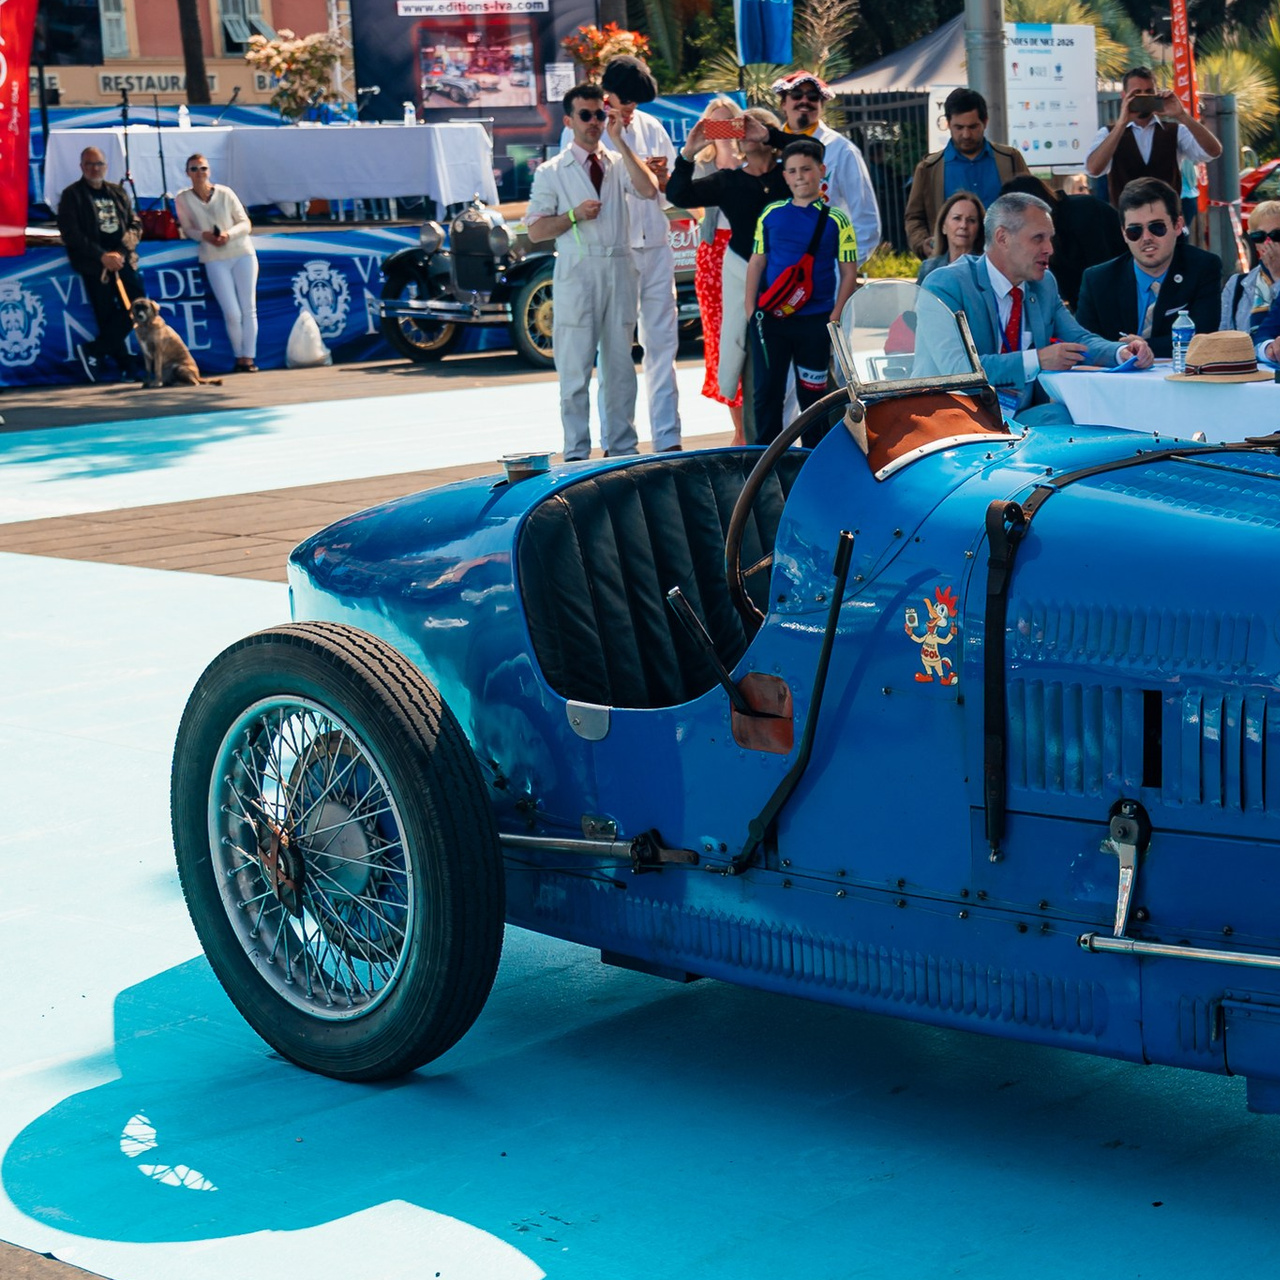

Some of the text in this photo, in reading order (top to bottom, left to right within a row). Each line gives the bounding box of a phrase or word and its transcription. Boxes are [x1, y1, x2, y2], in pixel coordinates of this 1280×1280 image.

[402, 0, 545, 14] www.editions-lva.com
[101, 75, 216, 92] RESTAURT
[158, 266, 205, 300] DE
